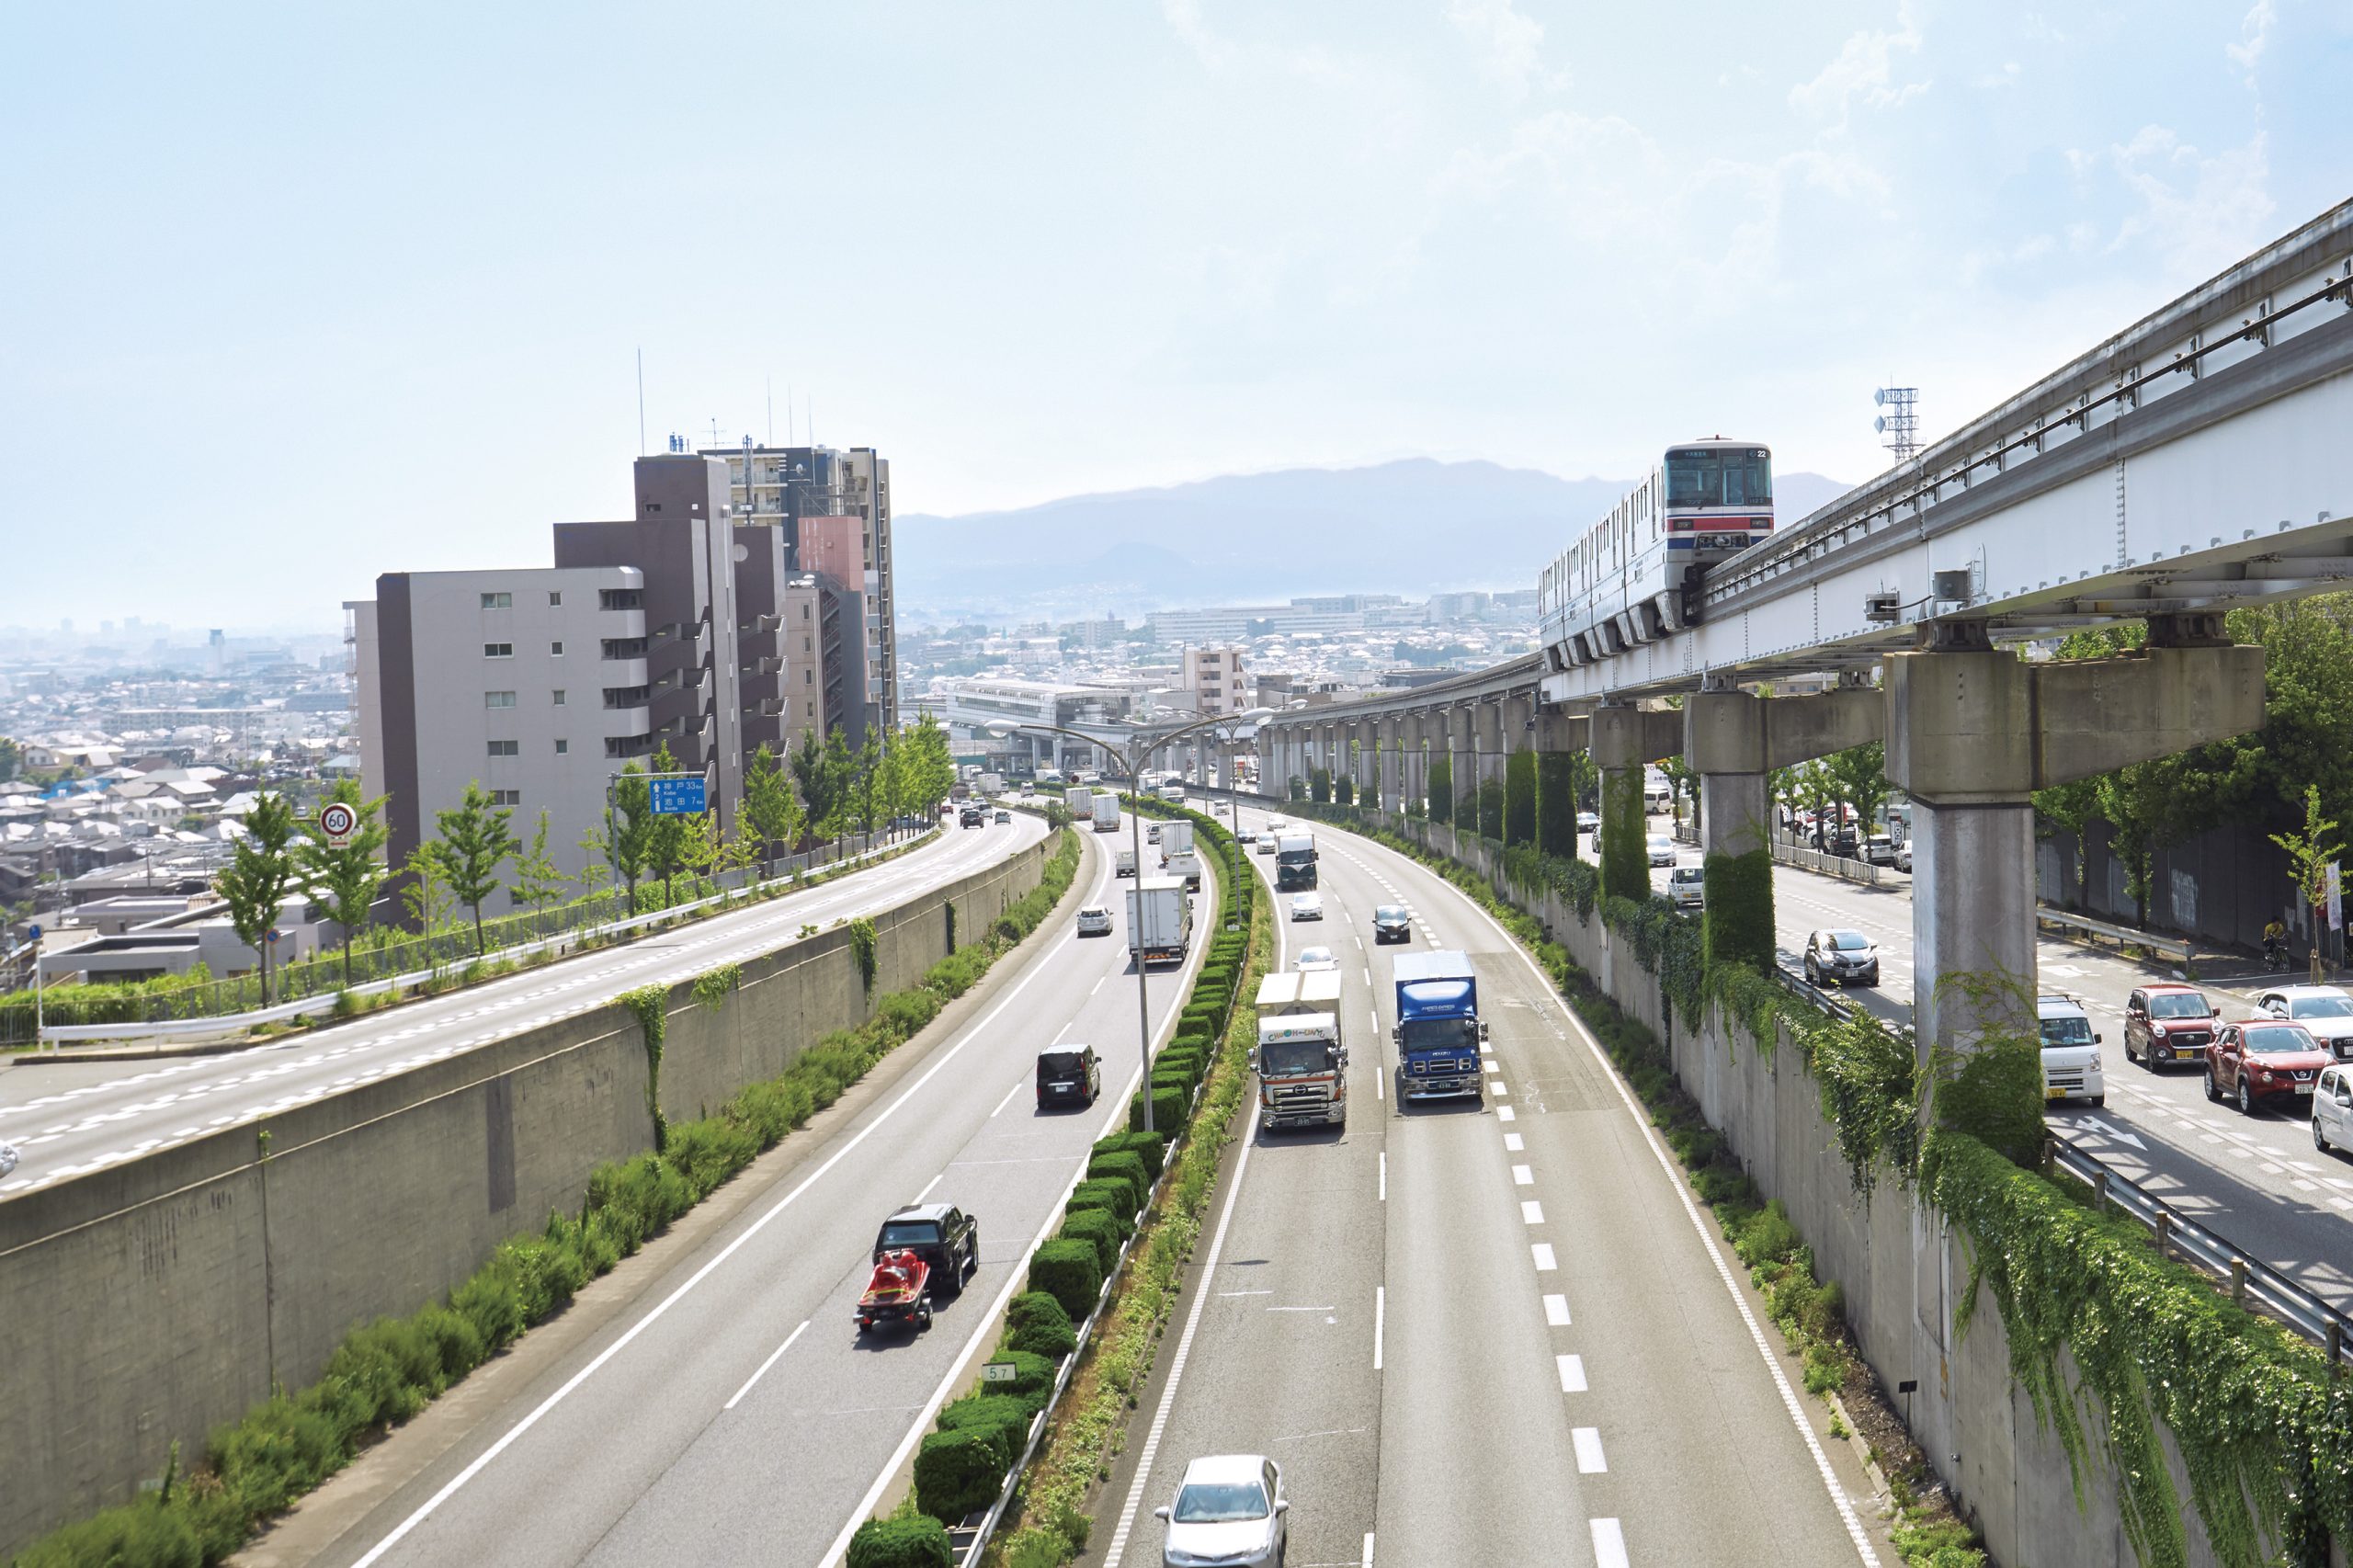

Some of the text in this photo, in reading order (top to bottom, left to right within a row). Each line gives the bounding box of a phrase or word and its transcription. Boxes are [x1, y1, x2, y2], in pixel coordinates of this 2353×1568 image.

[1756, 449, 1767, 458] 22
[686, 780, 696, 790] 33
[328, 813, 346, 828] 60
